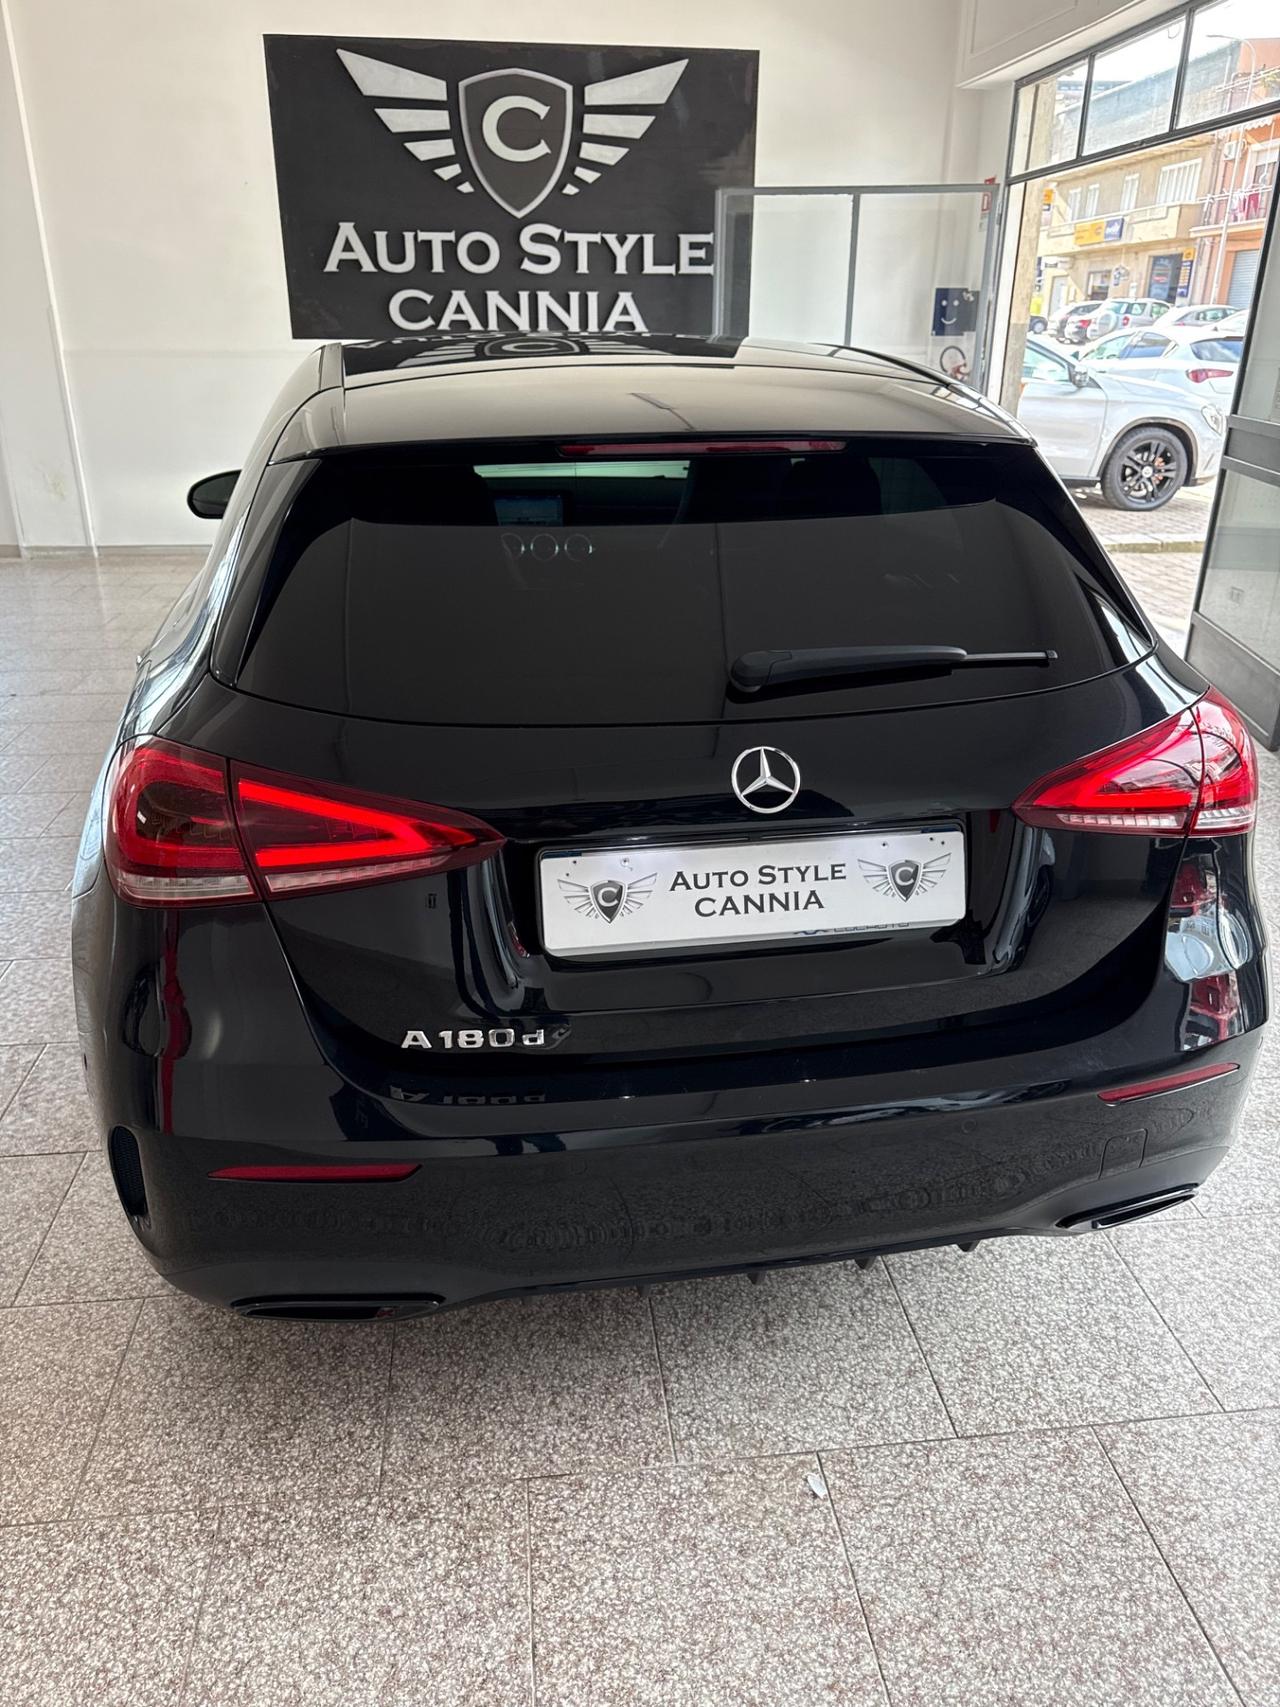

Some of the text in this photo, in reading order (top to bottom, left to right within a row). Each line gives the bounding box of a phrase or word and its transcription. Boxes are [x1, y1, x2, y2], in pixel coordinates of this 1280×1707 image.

[482, 95, 552, 163] C
[388, 289, 649, 333] CANNIA
[694, 889, 825, 918] CANNIA
